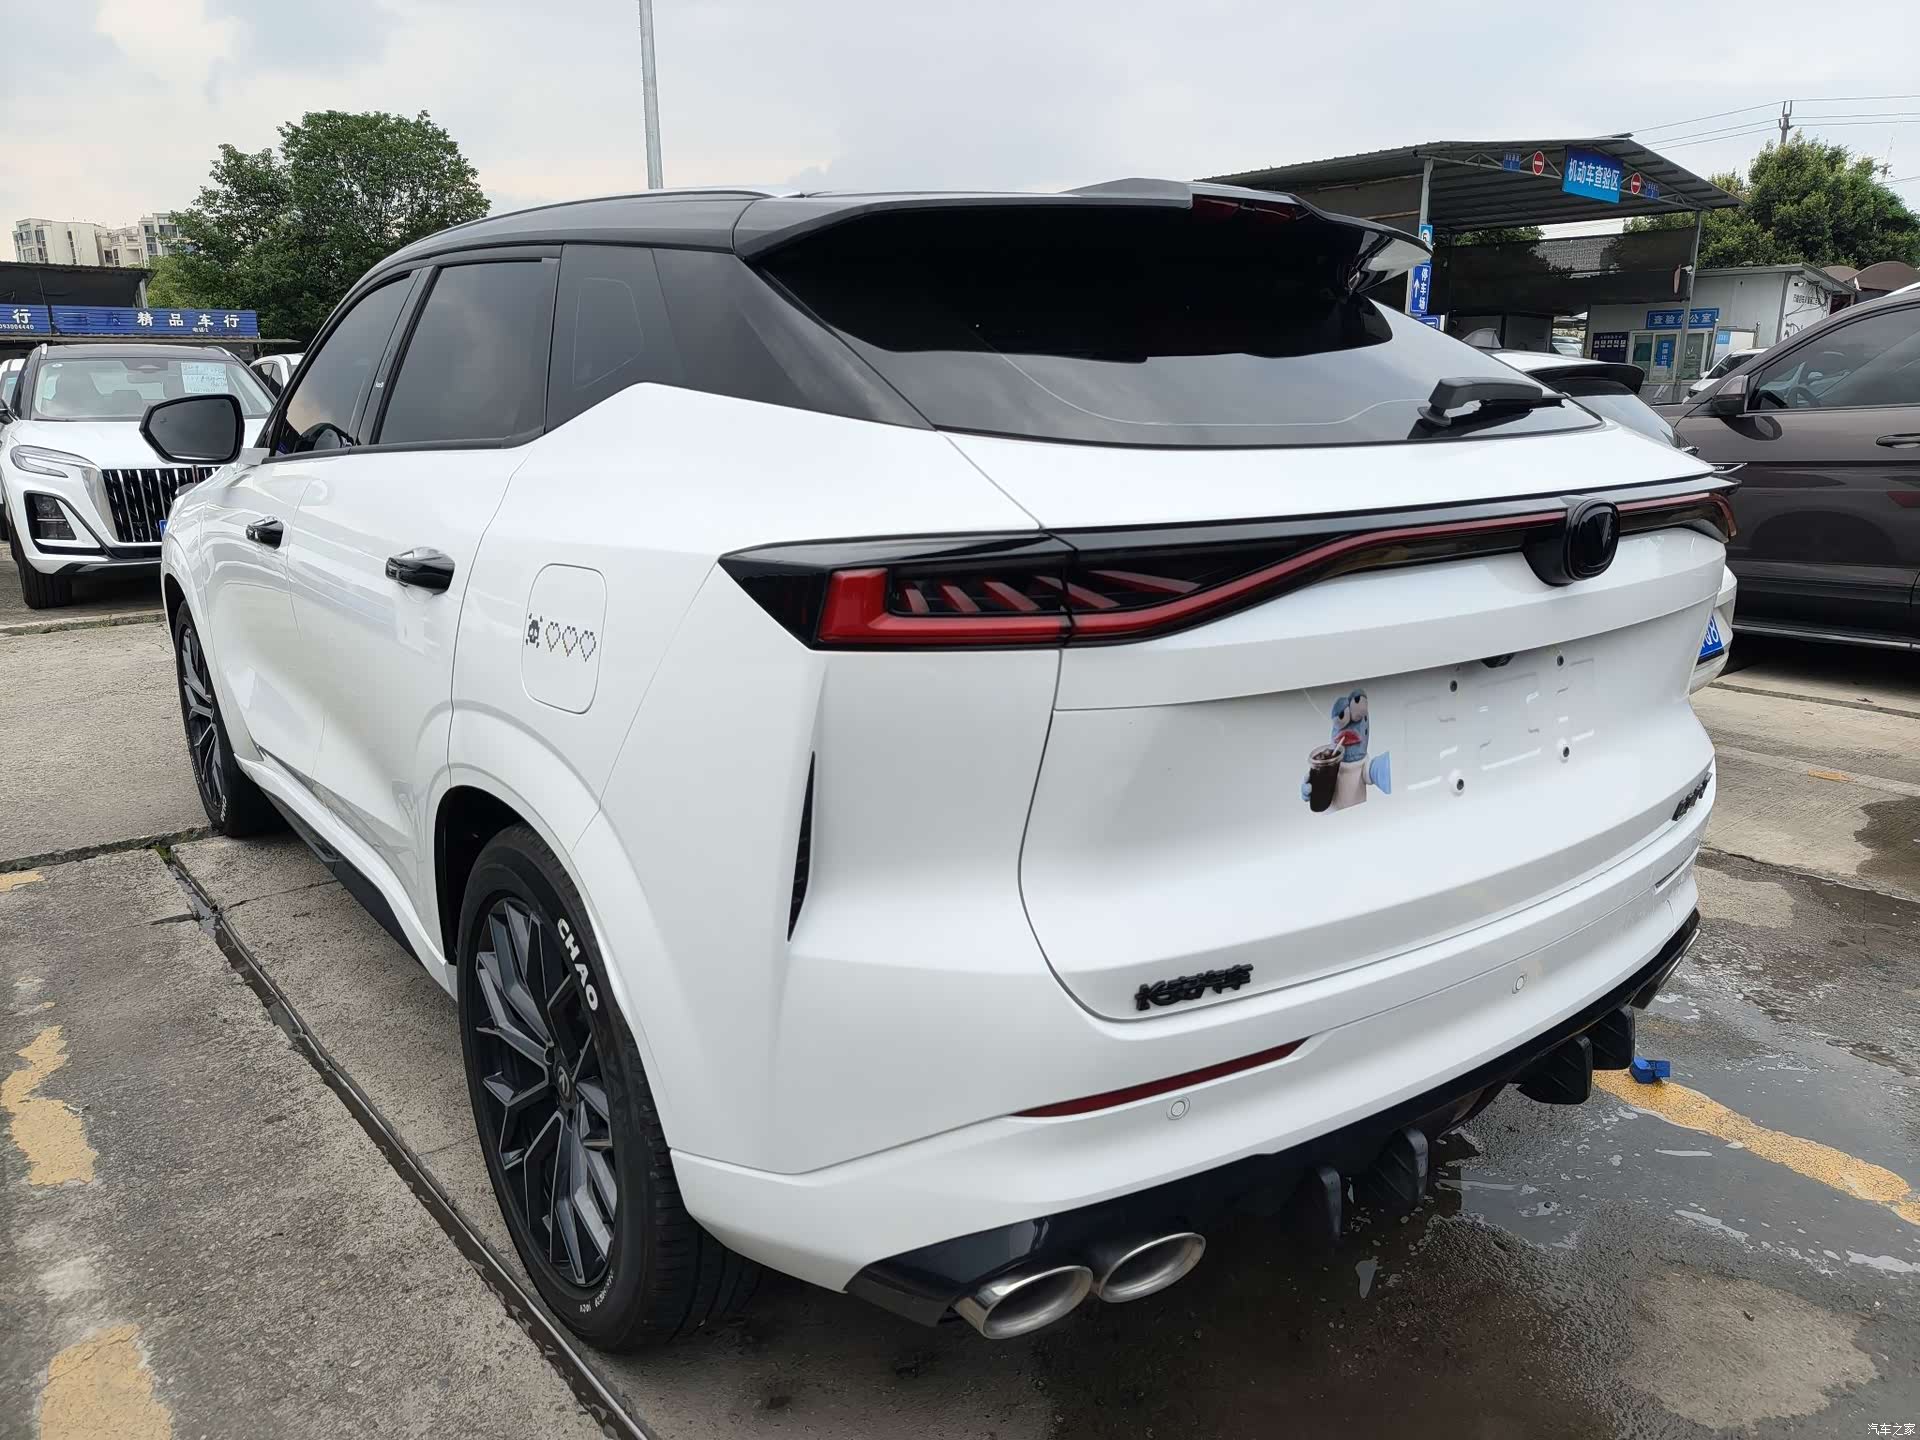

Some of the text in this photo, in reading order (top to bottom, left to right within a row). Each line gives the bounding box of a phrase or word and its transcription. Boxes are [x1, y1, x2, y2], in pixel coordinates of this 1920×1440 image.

[1568, 158, 1620, 191] 机动车查验区
[137, 311, 240, 328] 精品车行
[557, 918, 598, 1011] CHAO
